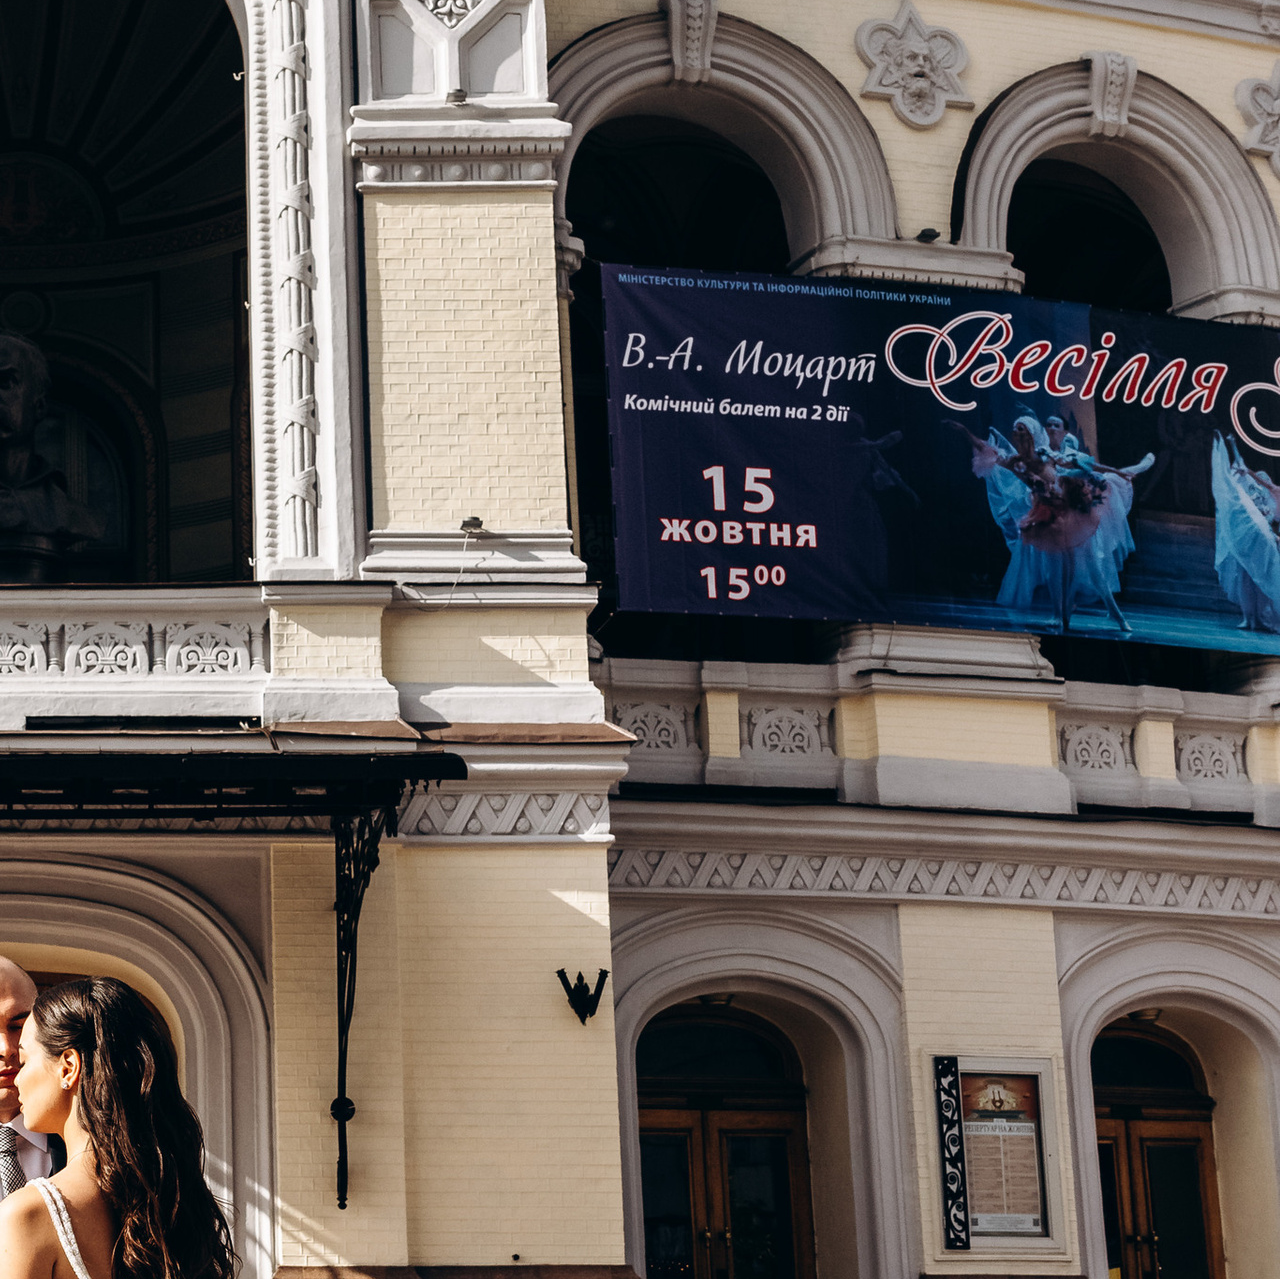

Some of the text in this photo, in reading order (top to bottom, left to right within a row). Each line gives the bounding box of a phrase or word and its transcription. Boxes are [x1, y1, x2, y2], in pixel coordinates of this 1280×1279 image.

[619, 273, 951, 306] МІНІСТЕРСТВО КУЛЬТУРИ ТА ІНФОРМАЦІЙНОЇ ПОЛІТИКИ УКРАЇНИ
[725, 339, 877, 397] Моцарт
[885, 310, 1228, 414] Весілля
[624, 393, 850, 422] Комічний балет на 2 дії
[702, 465, 775, 514] 15
